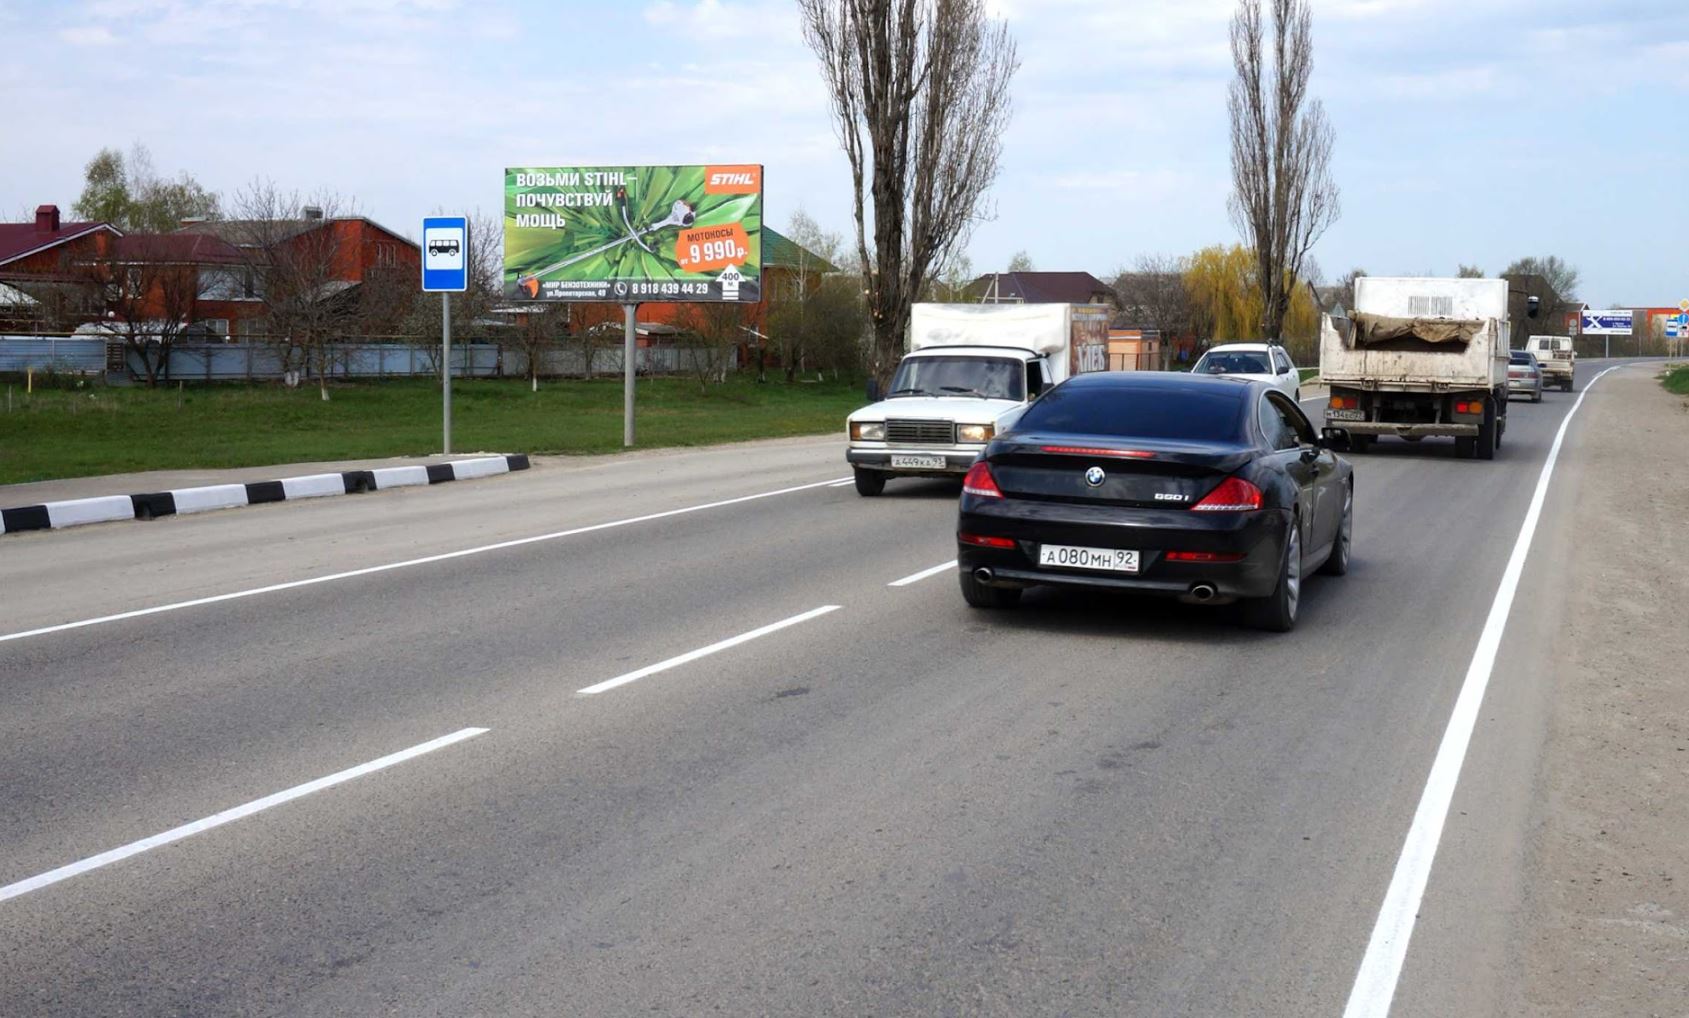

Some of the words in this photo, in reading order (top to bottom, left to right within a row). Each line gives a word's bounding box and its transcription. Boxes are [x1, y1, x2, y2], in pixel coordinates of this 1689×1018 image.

[516, 172, 580, 187] ВОЗЬМИ
[710, 173, 755, 185] STIHL
[516, 189, 613, 207] ПОЧУВСТВУЙ
[516, 213, 566, 230] МОЩЬ
[687, 228, 733, 242] МОТОКОСЫ
[721, 272, 740, 281] 400
[632, 283, 638, 294] 8
[641, 283, 659, 294] 918
[661, 283, 679, 294] 439
[681, 283, 693, 294] 44
[696, 283, 708, 294] 29
